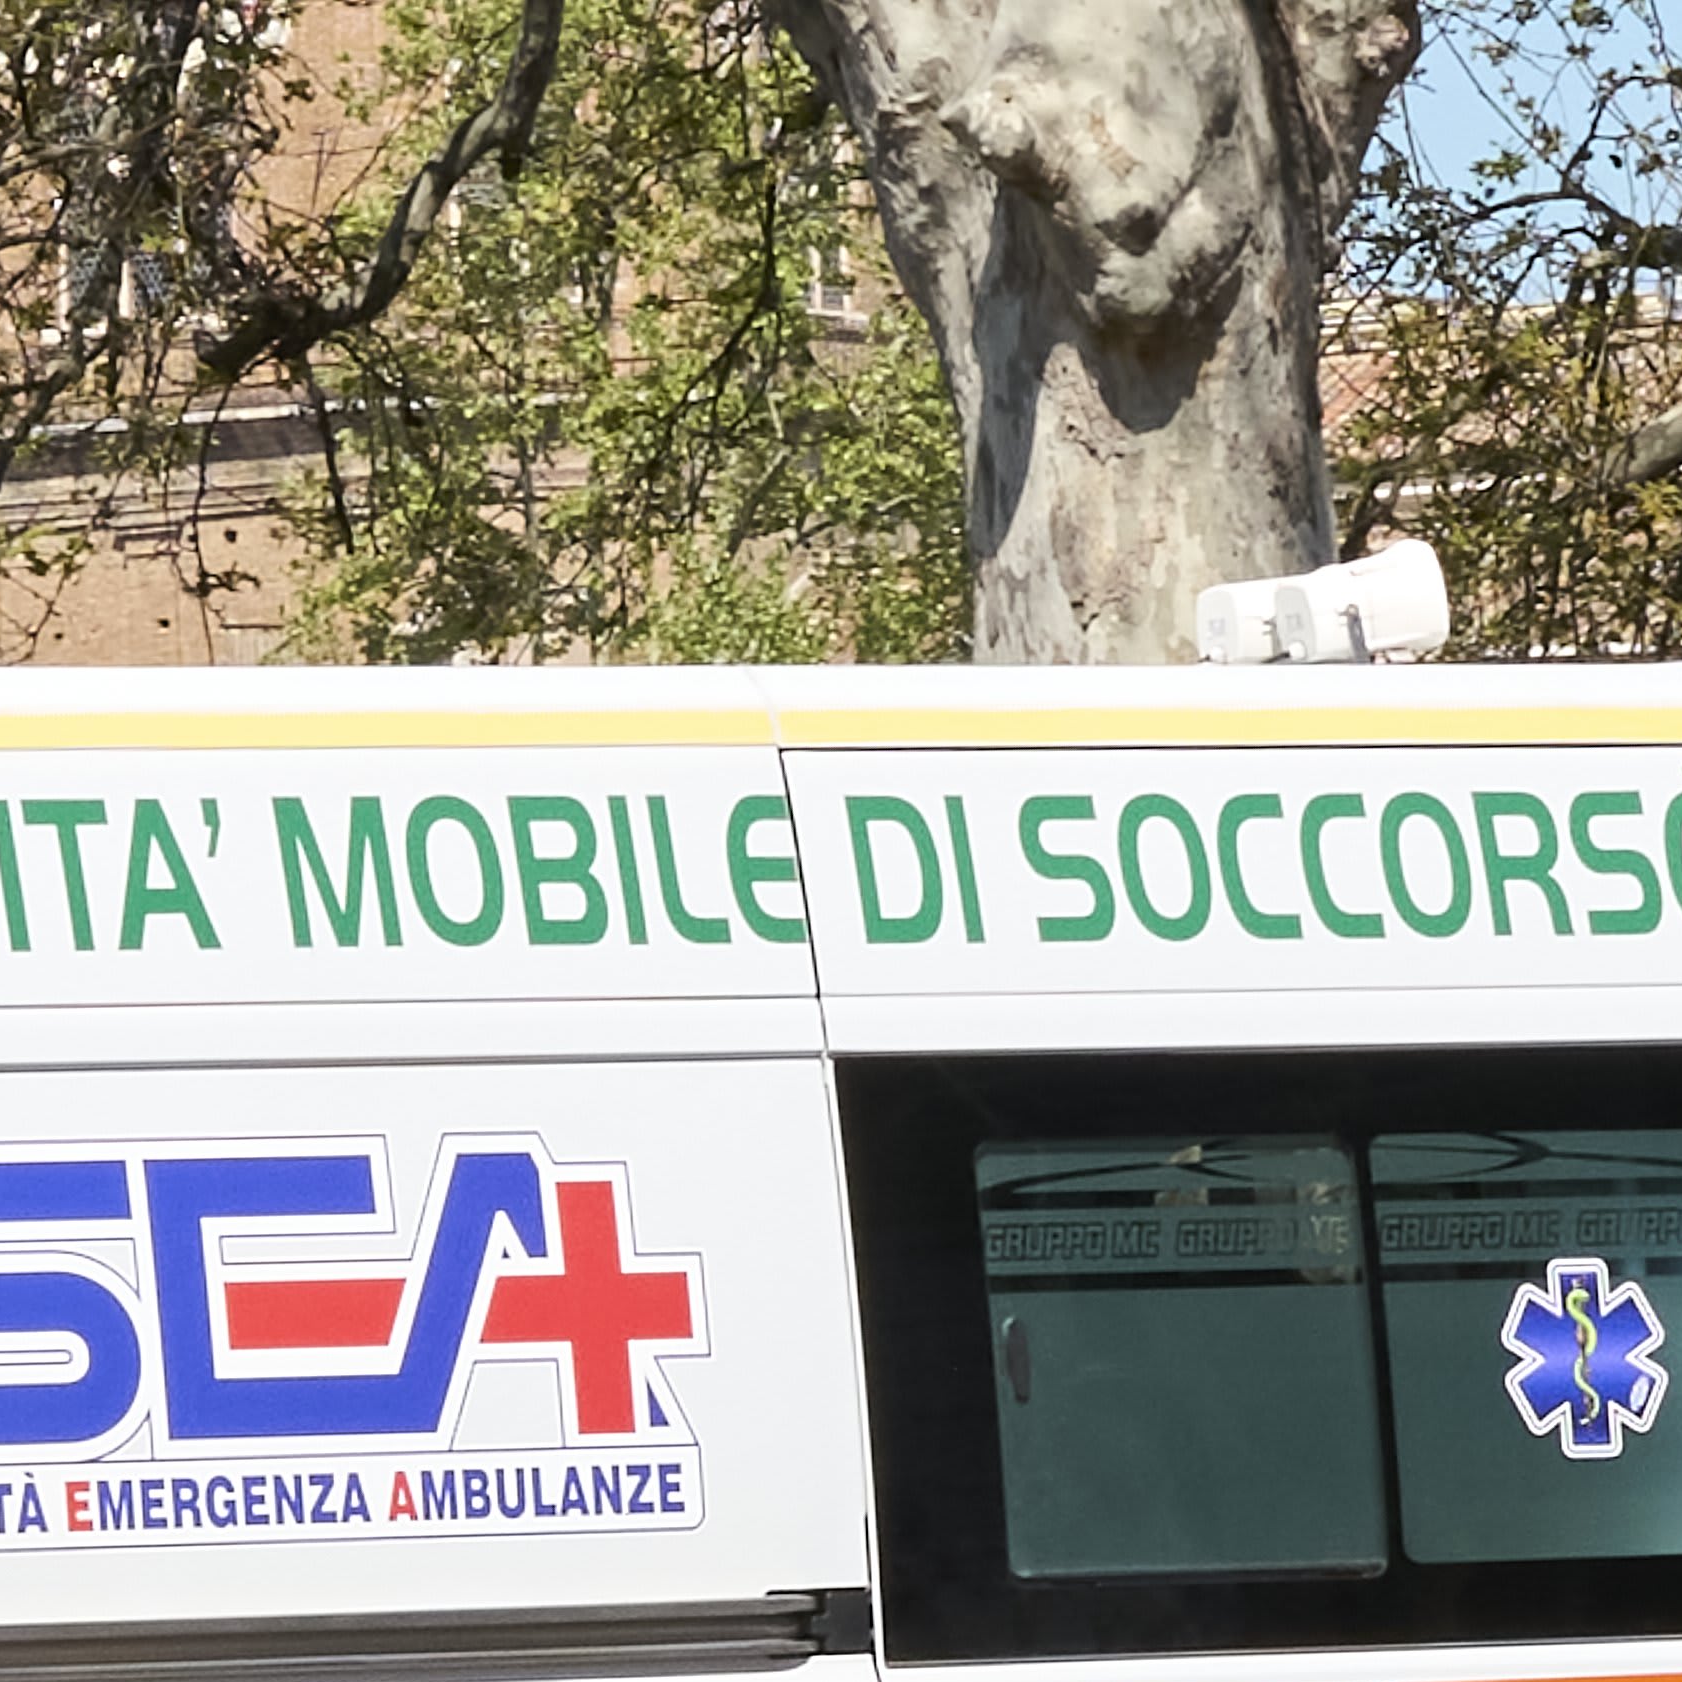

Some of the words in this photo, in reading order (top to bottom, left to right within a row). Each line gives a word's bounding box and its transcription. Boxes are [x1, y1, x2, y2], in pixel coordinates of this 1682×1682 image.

[272, 795, 809, 948] MOBILE
[845, 796, 985, 943] DI
[986, 1222, 1105, 1261] GRUPPO
[1113, 1221, 1159, 1258] MC
[1381, 1213, 1503, 1251] GRUPPO
[1513, 1211, 1561, 1247] MC
[64, 1472, 371, 1533] EMERGENZA
[387, 1462, 686, 1521] AMBULANZE
